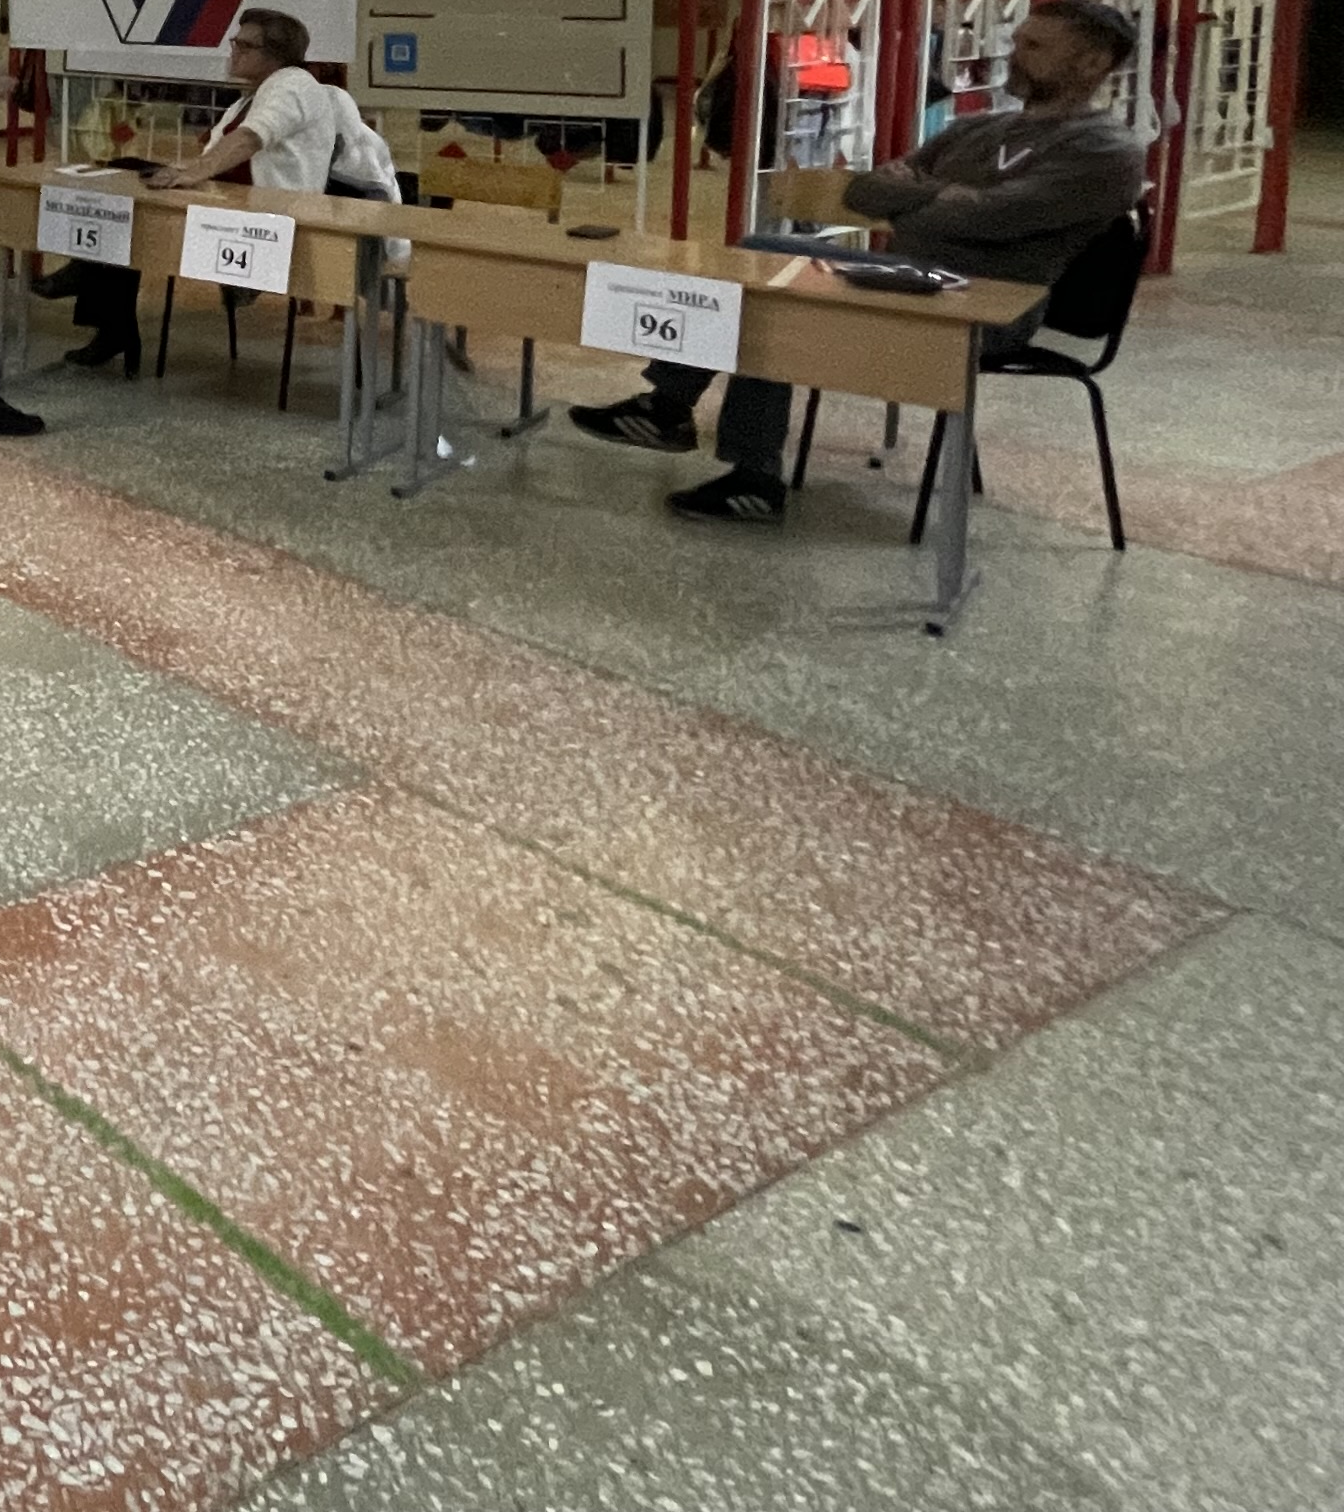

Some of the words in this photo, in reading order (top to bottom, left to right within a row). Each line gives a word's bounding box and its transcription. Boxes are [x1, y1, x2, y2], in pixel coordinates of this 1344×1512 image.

[76, 228, 98, 248] 15
[242, 226, 279, 242] МИРА
[221, 247, 247, 269] 94
[667, 289, 720, 312] МИРА
[639, 314, 678, 341] 96
